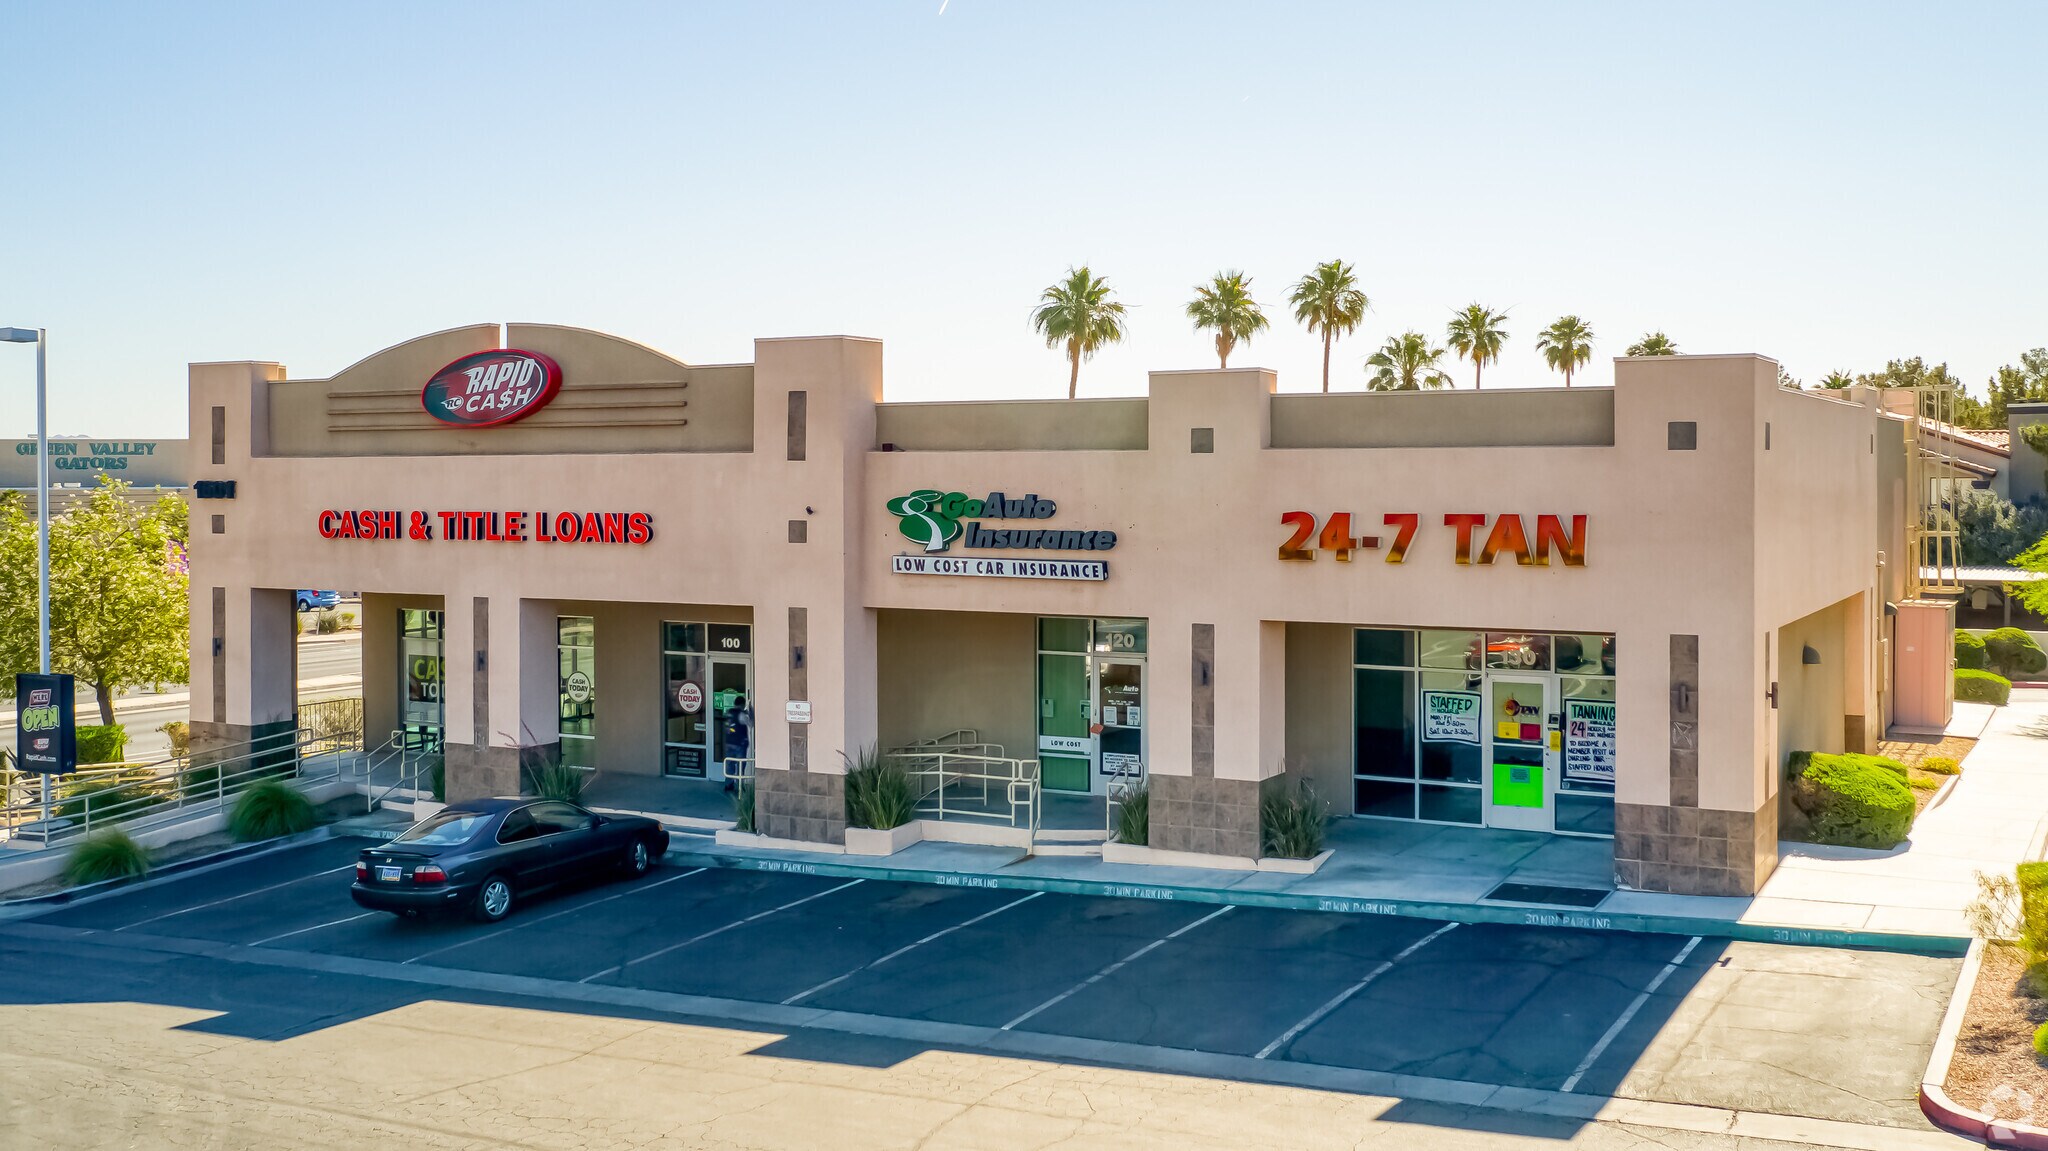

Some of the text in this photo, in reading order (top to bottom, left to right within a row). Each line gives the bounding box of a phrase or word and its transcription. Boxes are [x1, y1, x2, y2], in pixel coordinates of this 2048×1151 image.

[462, 359, 535, 394] RAPID
[90, 443, 156, 455] VALLEY
[55, 457, 127, 469] GATORS
[318, 510, 654, 544] CASH & TITLE LOANS
[964, 522, 1117, 550] Insurance
[1278, 511, 1589, 567] 24-7 TAN
[895, 558, 1100, 578] LOW COST CAR INSURANCE
[721, 637, 740, 649] 100
[1105, 633, 1135, 648] 120
[1502, 649, 1537, 666] 130
[421, 682, 445, 697] TO
[568, 684, 589, 692] TODAY
[680, 694, 700, 703] TODAY
[1431, 695, 1472, 710] STAFFED
[22, 706, 59, 731] OPEN
[1571, 704, 1615, 721] TANNING
[1571, 721, 1586, 738] 24
[1066, 740, 1081, 748] COST
[1568, 763, 1592, 771] STAFFED
[758, 860, 815, 873] 30 MIN PARKING
[935, 875, 998, 888] 30 MIN PARKING
[1103, 886, 1173, 899] 30 MIN PARKING
[1318, 900, 1397, 915] 30 MIN PARKING
[1525, 914, 1610, 929] 30 MIN PARKING
